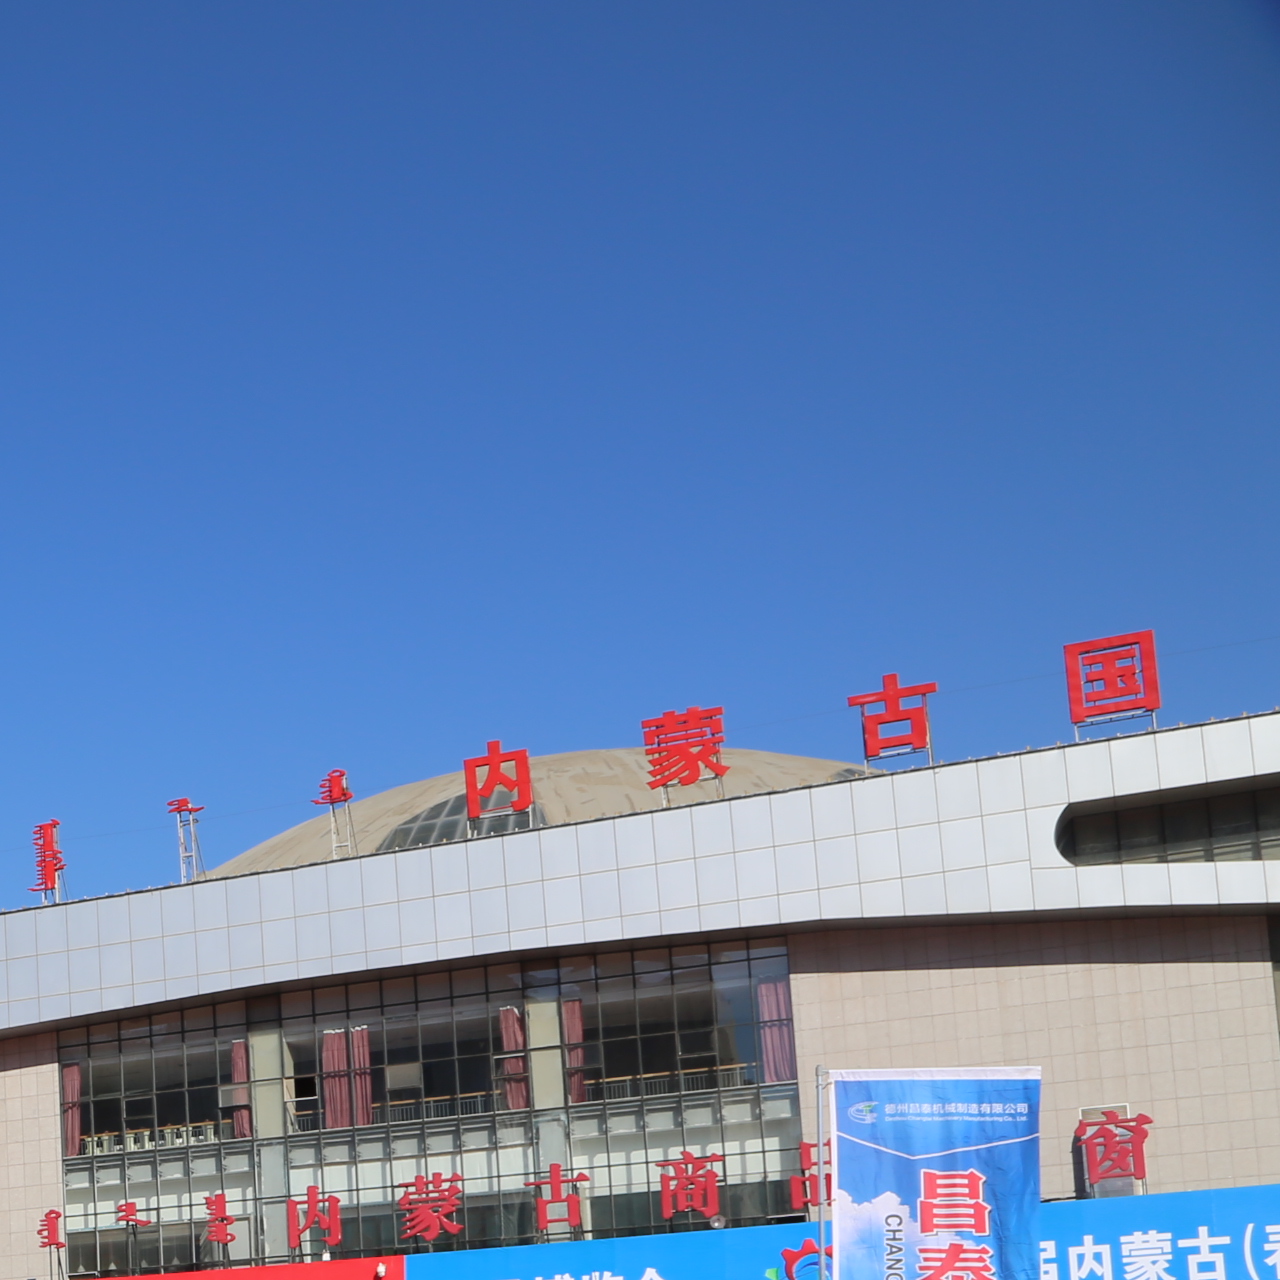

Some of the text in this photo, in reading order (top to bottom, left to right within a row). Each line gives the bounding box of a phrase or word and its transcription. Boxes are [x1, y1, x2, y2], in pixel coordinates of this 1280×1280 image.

[462, 629, 1160, 819] 内蒙古国
[884, 1103, 1029, 1114] 德州昌泰机械制造有限公司
